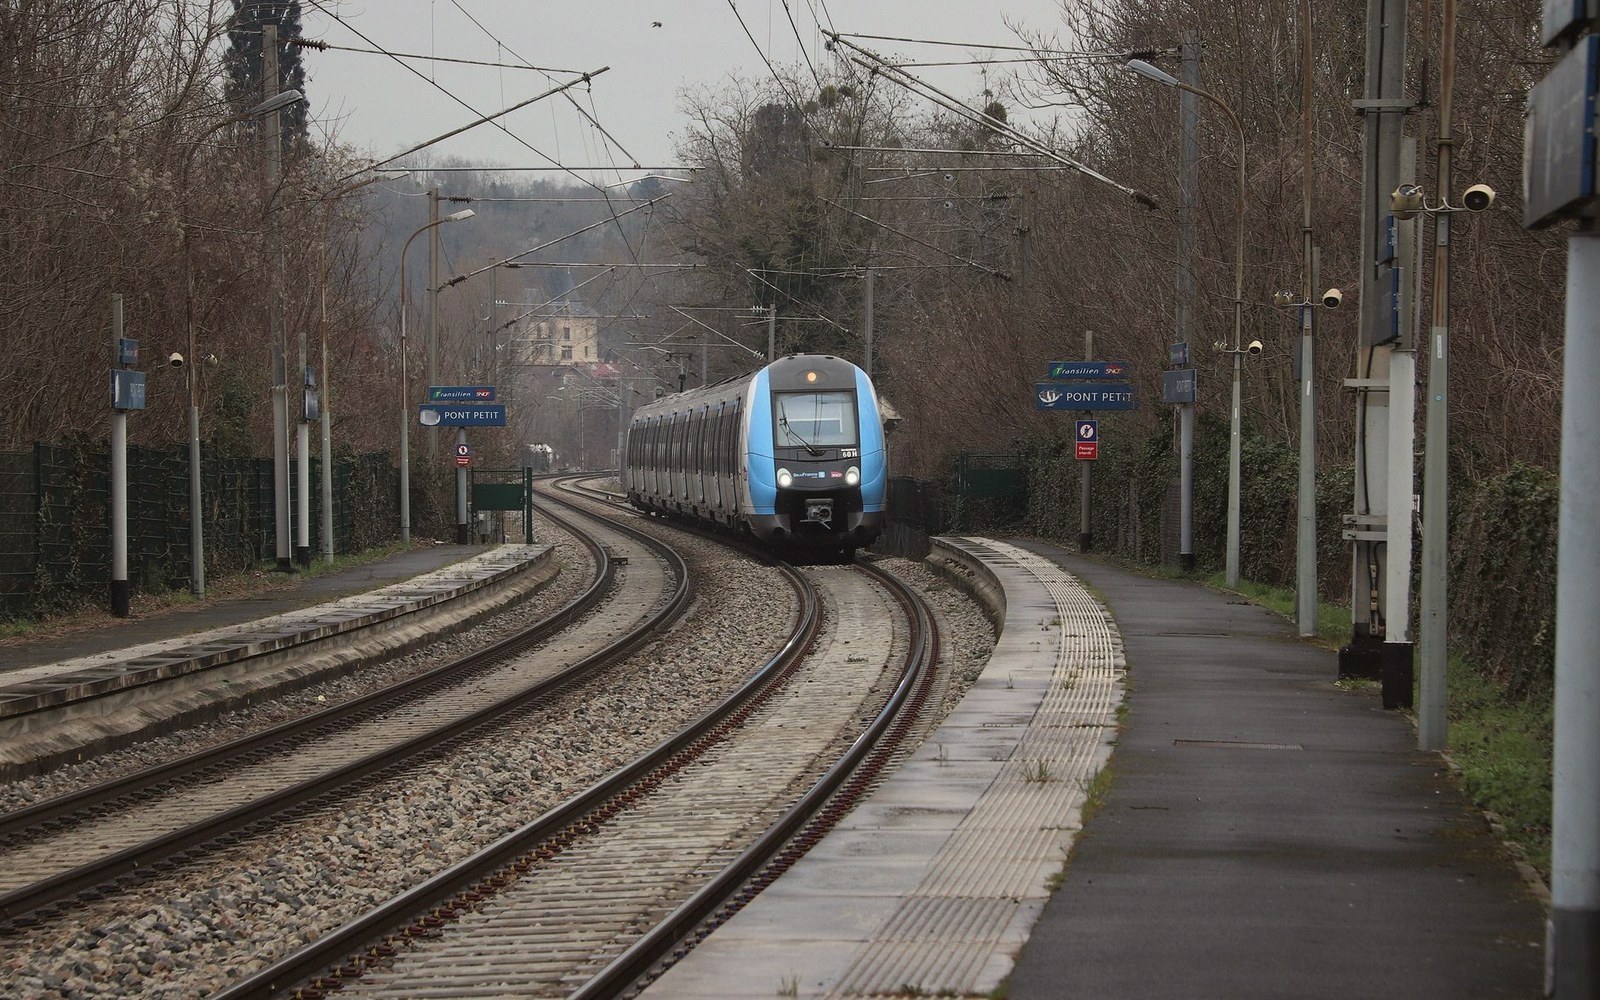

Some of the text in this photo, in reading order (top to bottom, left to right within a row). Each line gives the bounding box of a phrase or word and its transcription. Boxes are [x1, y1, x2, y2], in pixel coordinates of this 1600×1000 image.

[1066, 392, 1132, 402] PONT PETIT
[444, 411, 499, 419] PONT PETIT
